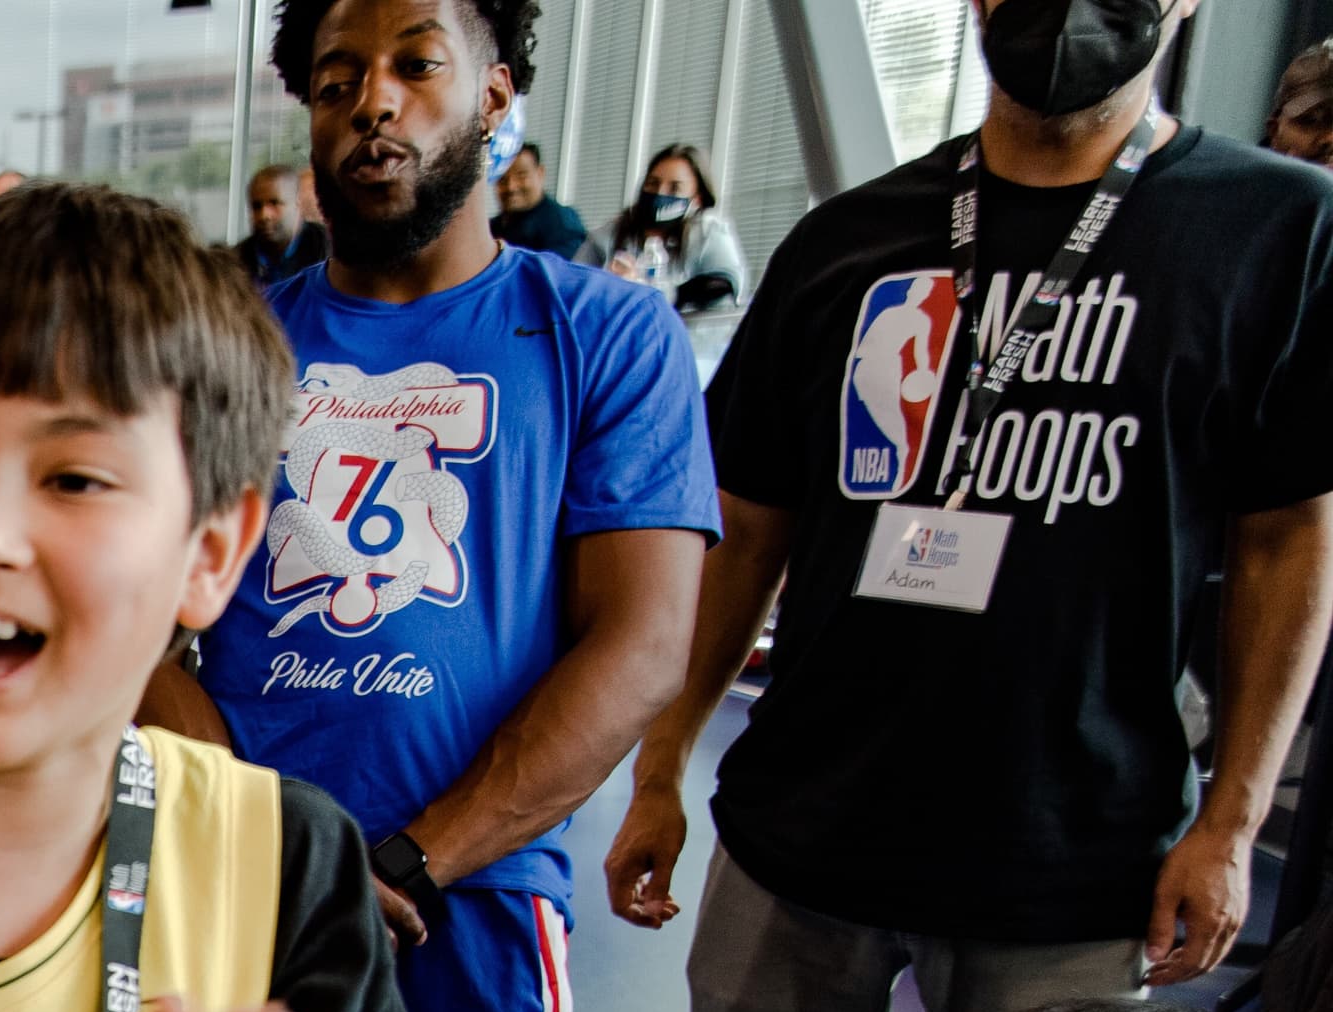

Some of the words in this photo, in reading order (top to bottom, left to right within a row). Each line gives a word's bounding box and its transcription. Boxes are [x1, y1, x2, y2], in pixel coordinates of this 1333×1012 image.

[951, 195, 964, 249] LEARN
[961, 191, 977, 244] FRESH
[1064, 192, 1108, 250] LEARN
[1077, 195, 1122, 253] FRESH
[982, 329, 1025, 390] LEARN
[993, 332, 1036, 392] FRESH
[297, 394, 466, 427] Philadelphia
[851, 447, 890, 483] NBA
[333, 454, 404, 557] 76
[927, 548, 959, 568] Hoops
[933, 529, 959, 548] Math
[885, 570, 935, 590] Adam
[262, 651, 347, 696] Phila
[352, 653, 434, 699] Unite
